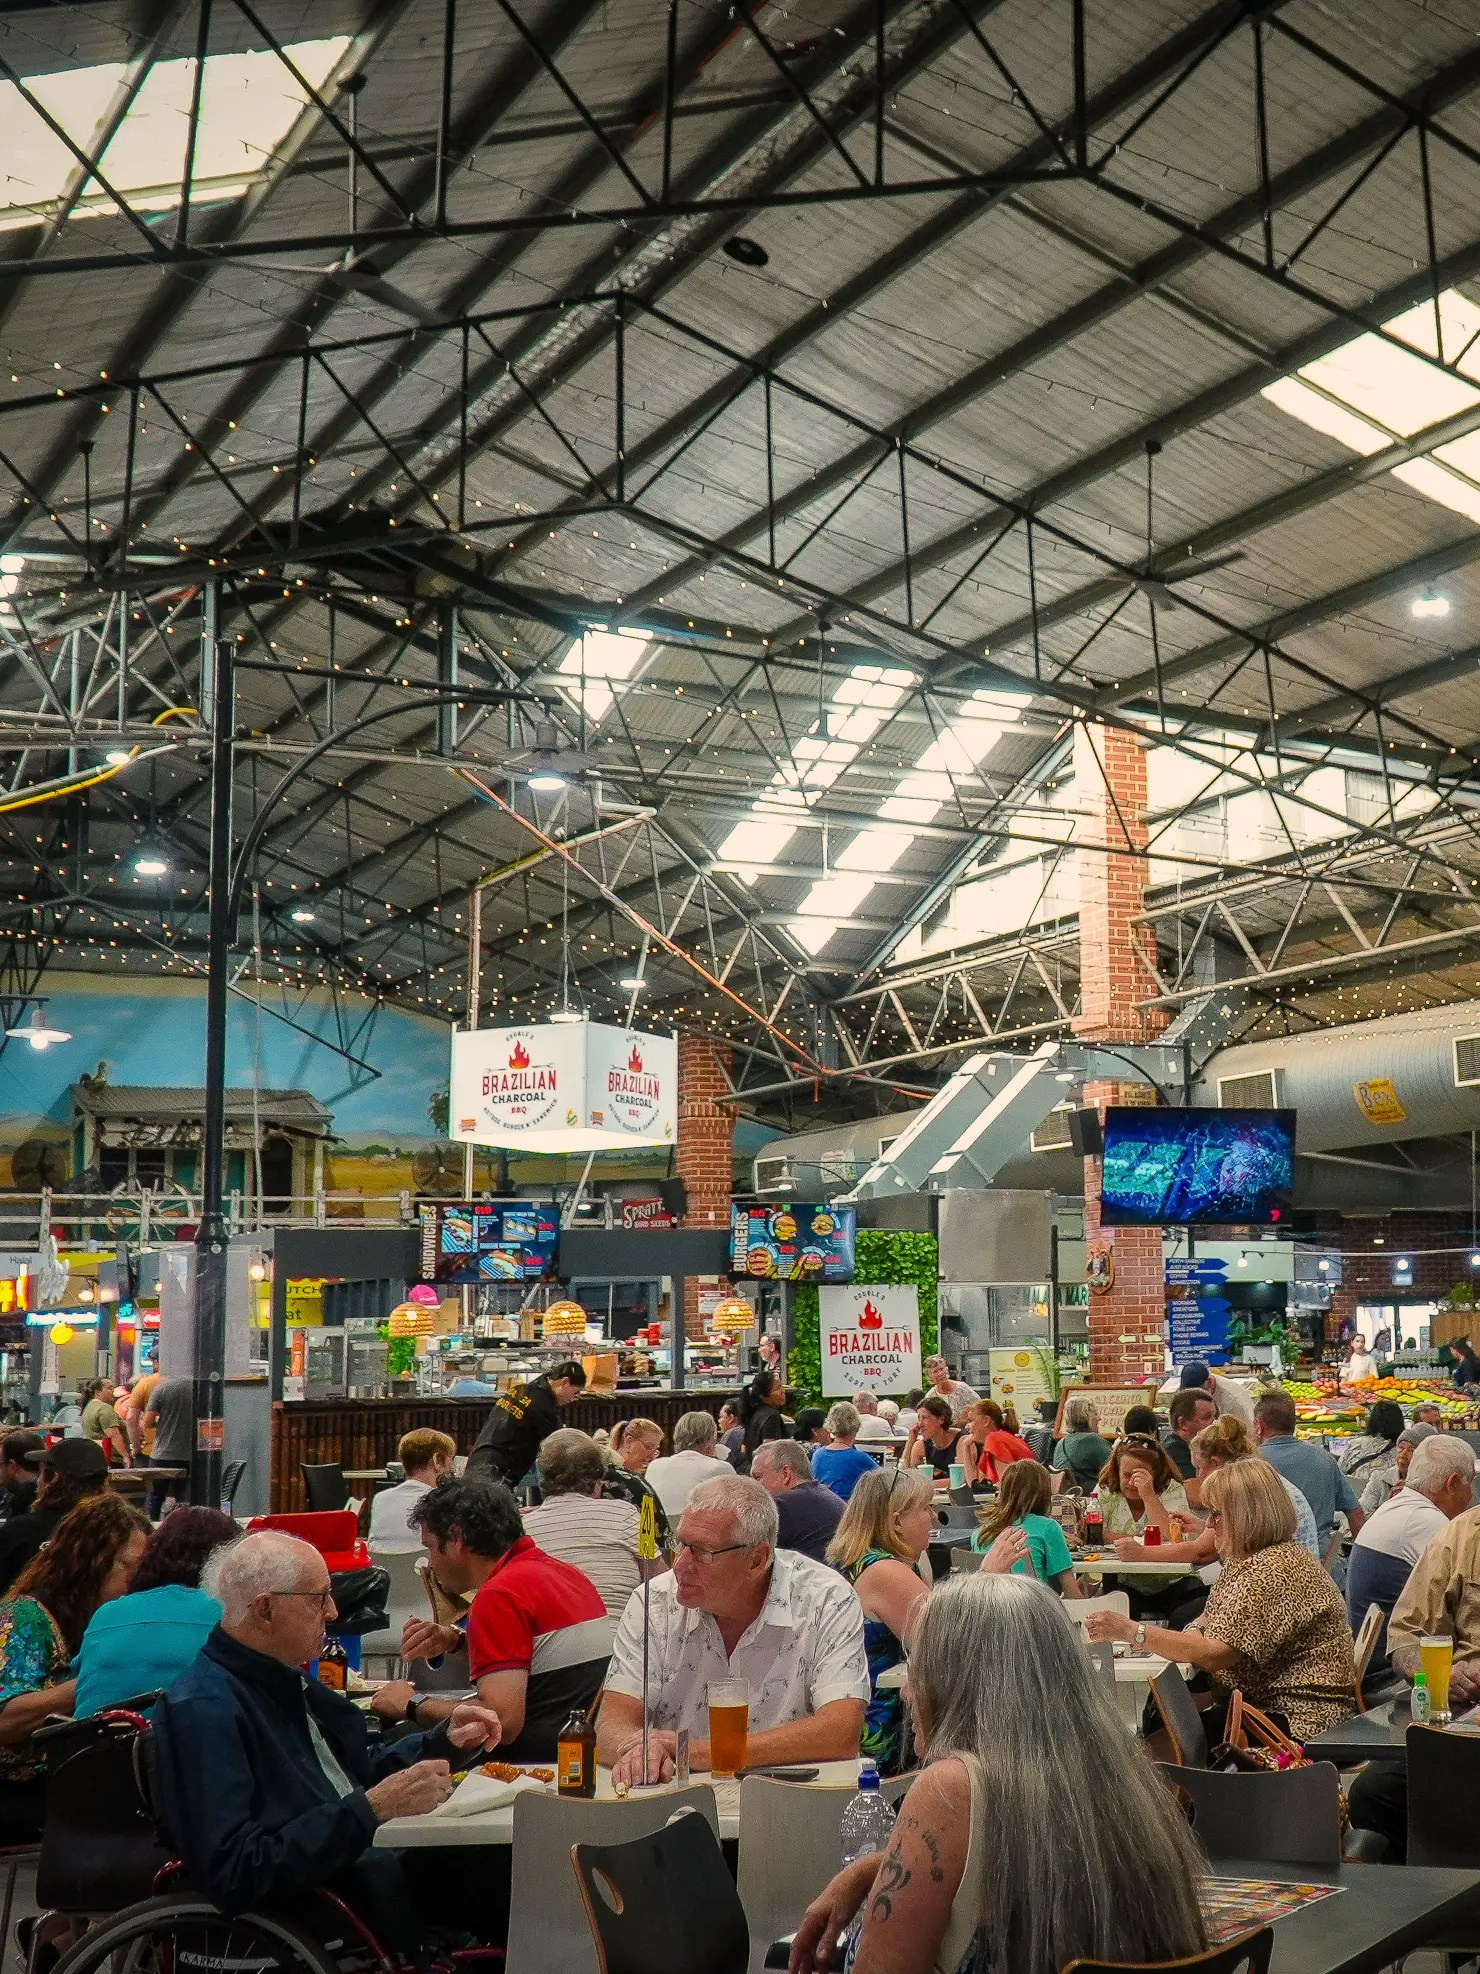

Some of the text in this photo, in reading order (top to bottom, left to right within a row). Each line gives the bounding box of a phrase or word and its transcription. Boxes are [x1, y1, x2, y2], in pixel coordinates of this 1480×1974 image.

[482, 1070, 557, 1096] BRAZILIAN
[608, 1071, 660, 1101] BRAZILIAN
[492, 1092, 547, 1105] CHARCOAL
[615, 1093, 653, 1109] CHARCOAL
[511, 1106, 527, 1115] BBQ
[628, 1108, 641, 1119] BBQ
[623, 1200, 667, 1230] SPRATT
[422, 1205, 437, 1280] SANDWICHES
[733, 1212, 749, 1272] BURGERS
[854, 1290, 880, 1301] DOUBLE
[829, 1331, 913, 1357] BRAZILIAN
[841, 1354, 903, 1365] CHARCOAL
[843, 1371, 864, 1388] SURF
[883, 1367, 902, 1386] TURF
[863, 1367, 882, 1377] BBQ
[184, 1951, 223, 1969] KARMA
